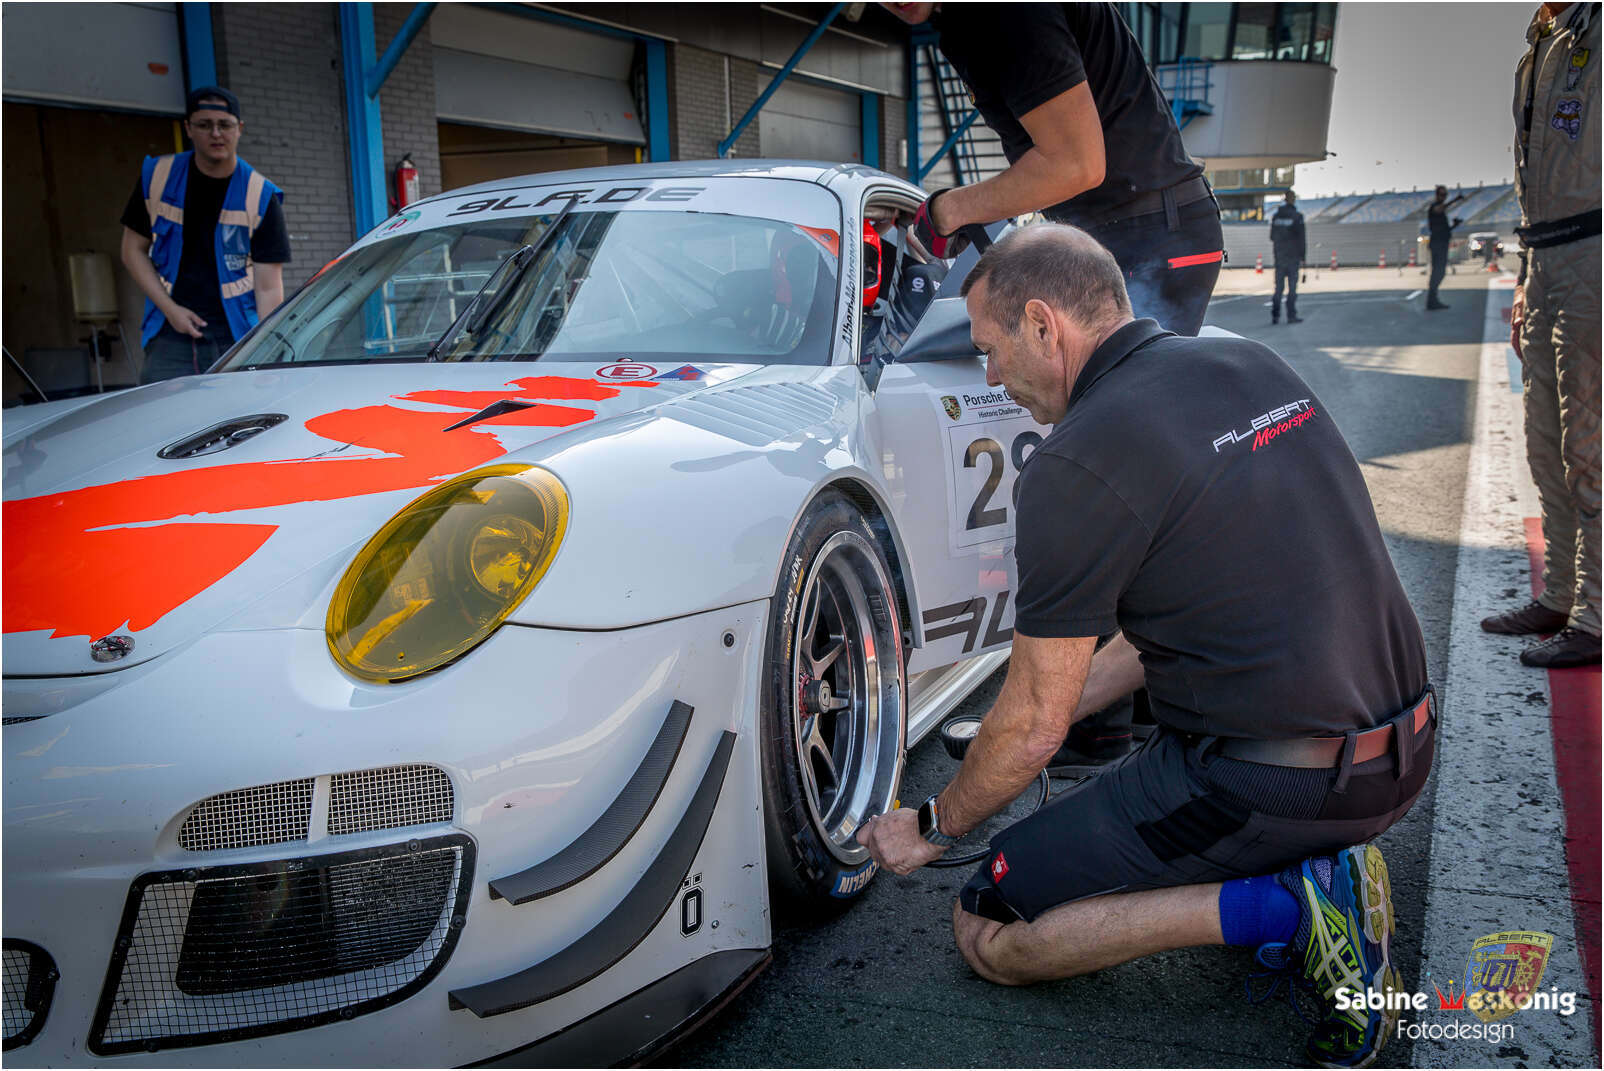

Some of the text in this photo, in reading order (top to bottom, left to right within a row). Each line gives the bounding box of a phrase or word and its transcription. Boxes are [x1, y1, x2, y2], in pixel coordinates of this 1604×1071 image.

[963, 391, 1004, 406] Porsche
[978, 407, 1023, 418] Historic Challenge
[1212, 399, 1310, 453] ALBERT
[1252, 406, 1316, 452] Motorsport
